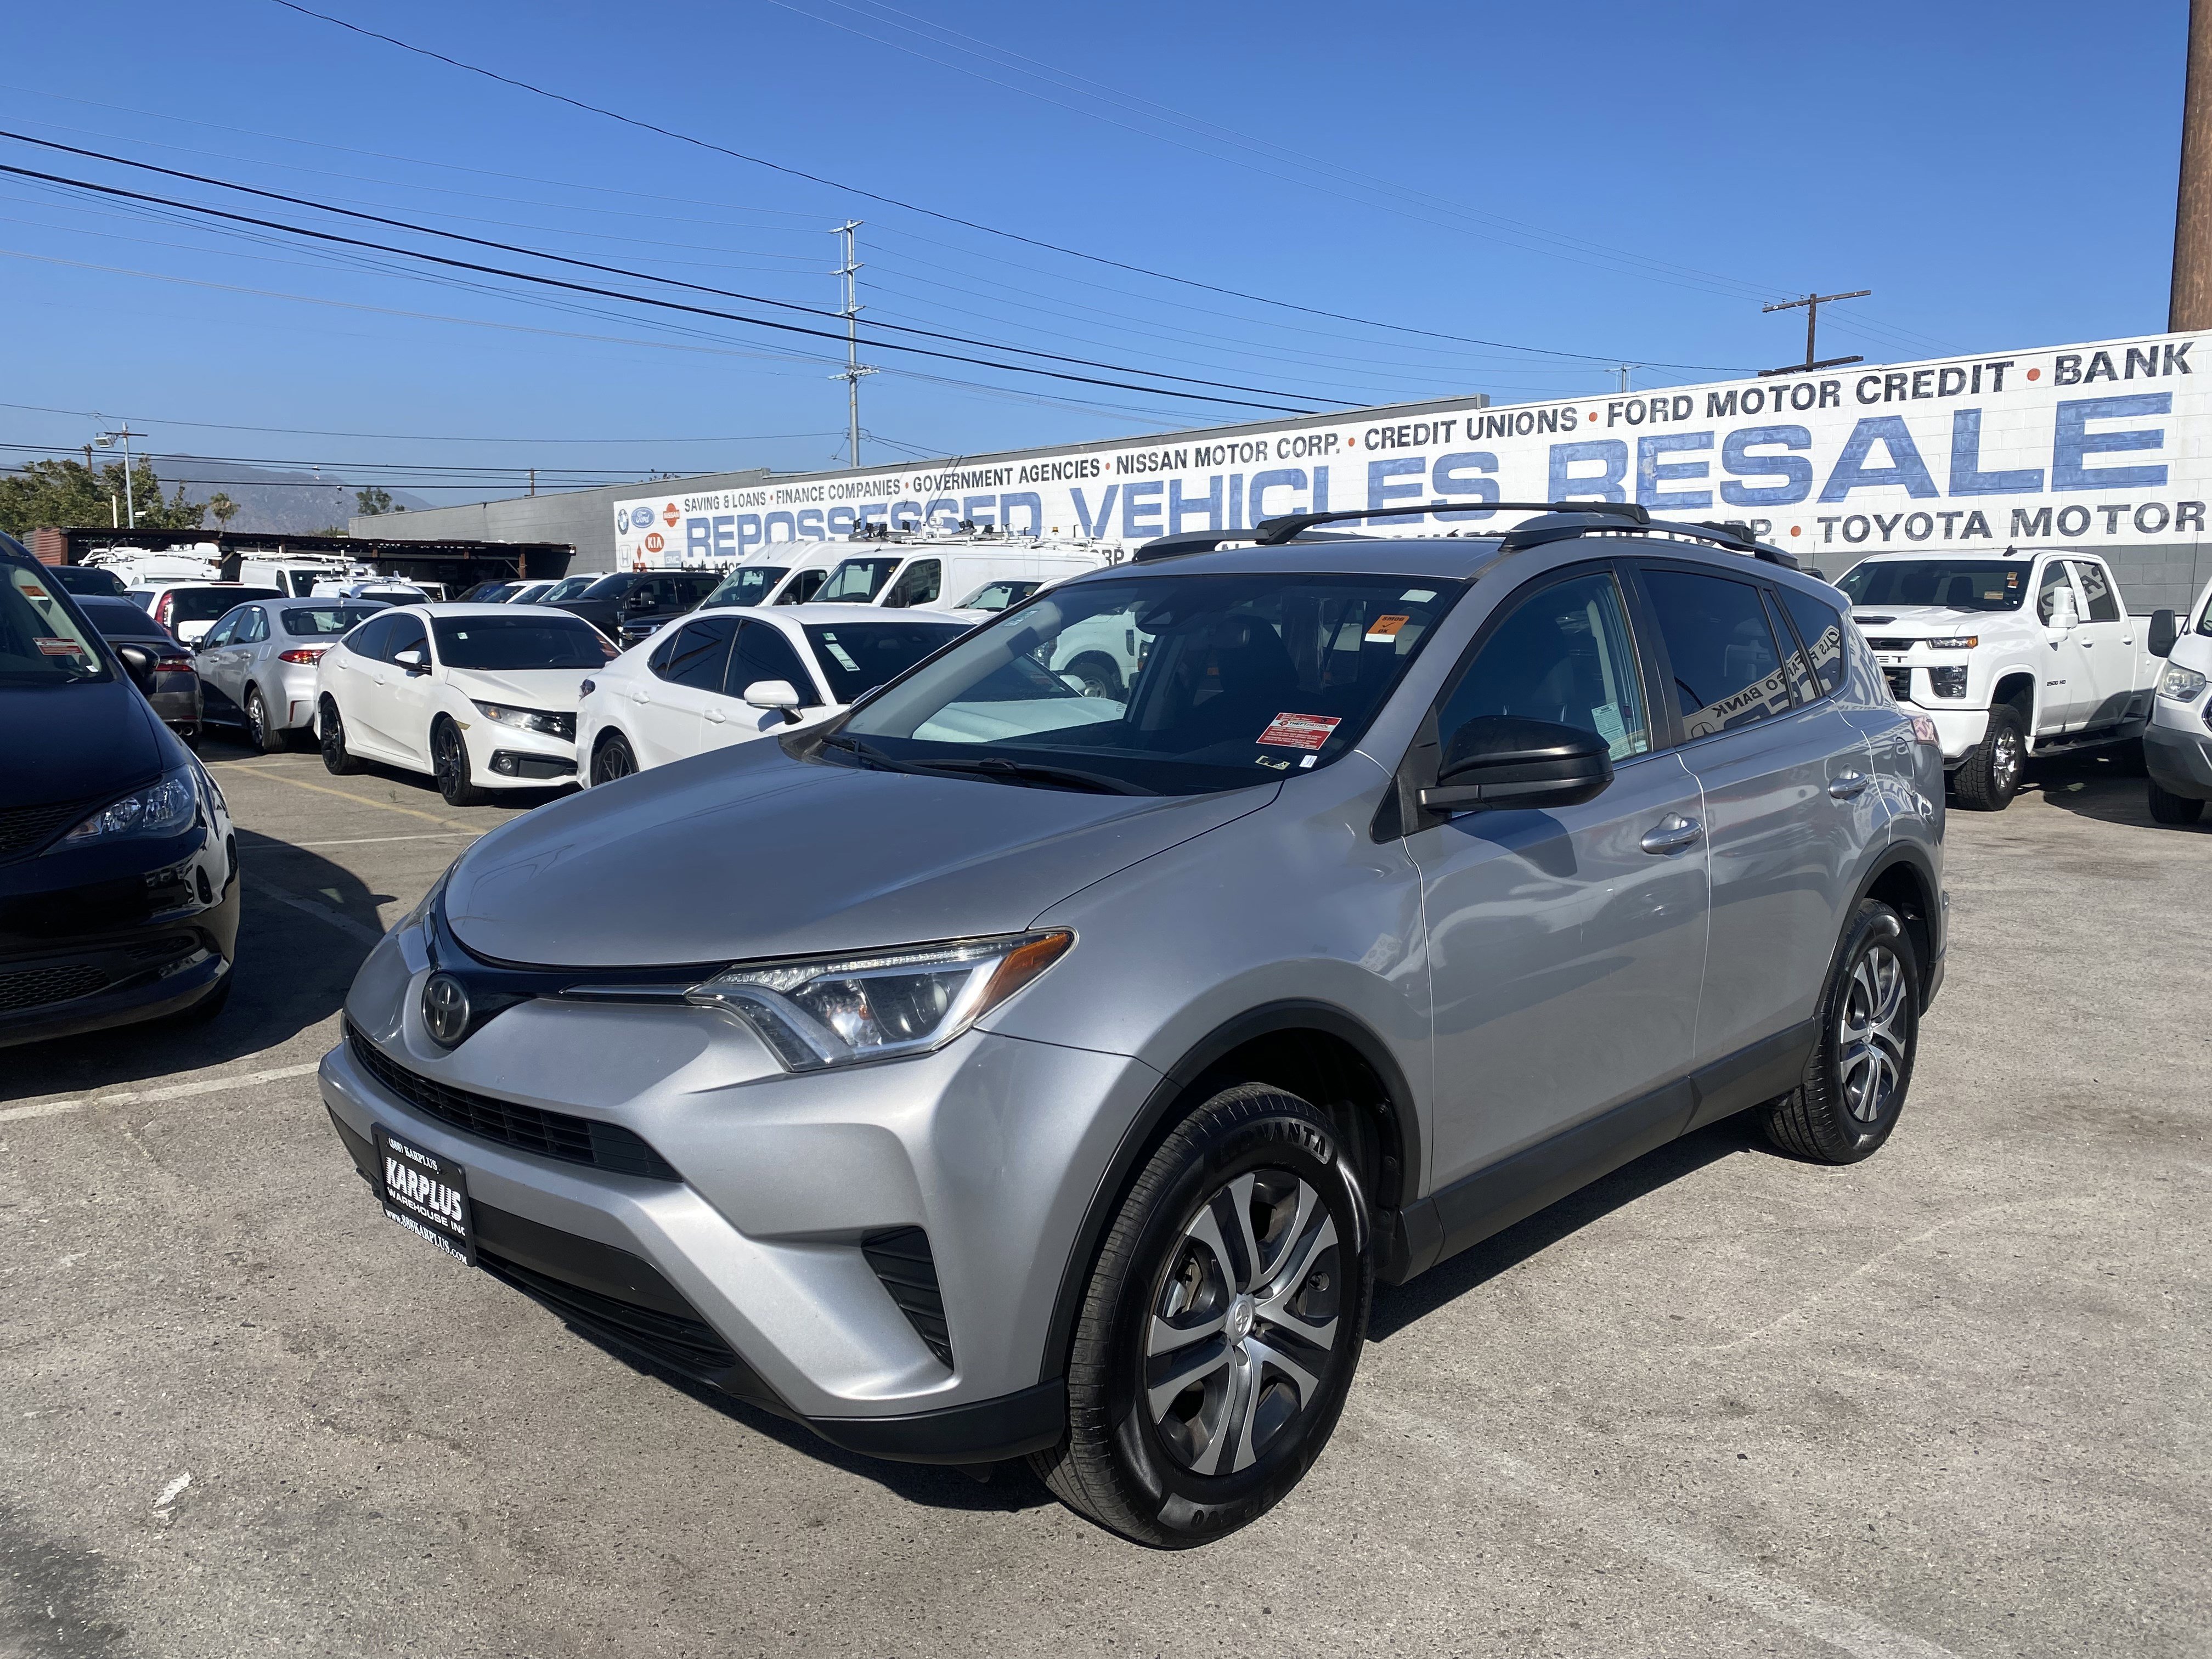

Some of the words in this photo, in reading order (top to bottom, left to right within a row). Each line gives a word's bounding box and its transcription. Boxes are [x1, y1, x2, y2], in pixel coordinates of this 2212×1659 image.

[684, 497, 720, 512] SAVING
[724, 495, 730, 509] &
[732, 492, 766, 508] LOANS
[776, 487, 824, 504] FINANCE
[828, 478, 901, 500] COMPANIES
[913, 466, 1013, 492] GOVERNMENT
[1019, 458, 1101, 483] AGENCIES
[1116, 449, 1188, 475] NISSAN
[1195, 440, 1268, 467] MOTOR
[1276, 433, 1340, 460] CORP.
[1364, 419, 1457, 452] CREDIT
[1466, 406, 1578, 441] UNIONS
[1607, 394, 1694, 428] FORD
[1707, 380, 1841, 418] MOTOR
[1855, 361, 2015, 405] CREDIT
[2055, 342, 2194, 386] BANK
[686, 492, 1042, 557] REPOSSESSED
[1069, 451, 1500, 540] VEHICLES
[1547, 391, 2174, 514] RESALE
[636, 511, 650, 523] Ford
[1817, 510, 1994, 544] TOYOTA
[2011, 501, 2208, 537] MOTOR
[648, 537, 662, 549] KIA
[666, 556, 679, 564] GMC
[404, 1146, 438, 1171] KARPLUS
[386, 1156, 462, 1222] KARPLUS
[387, 1186, 449, 1227] WAREHOUSE
[450, 1221, 466, 1237] INC
